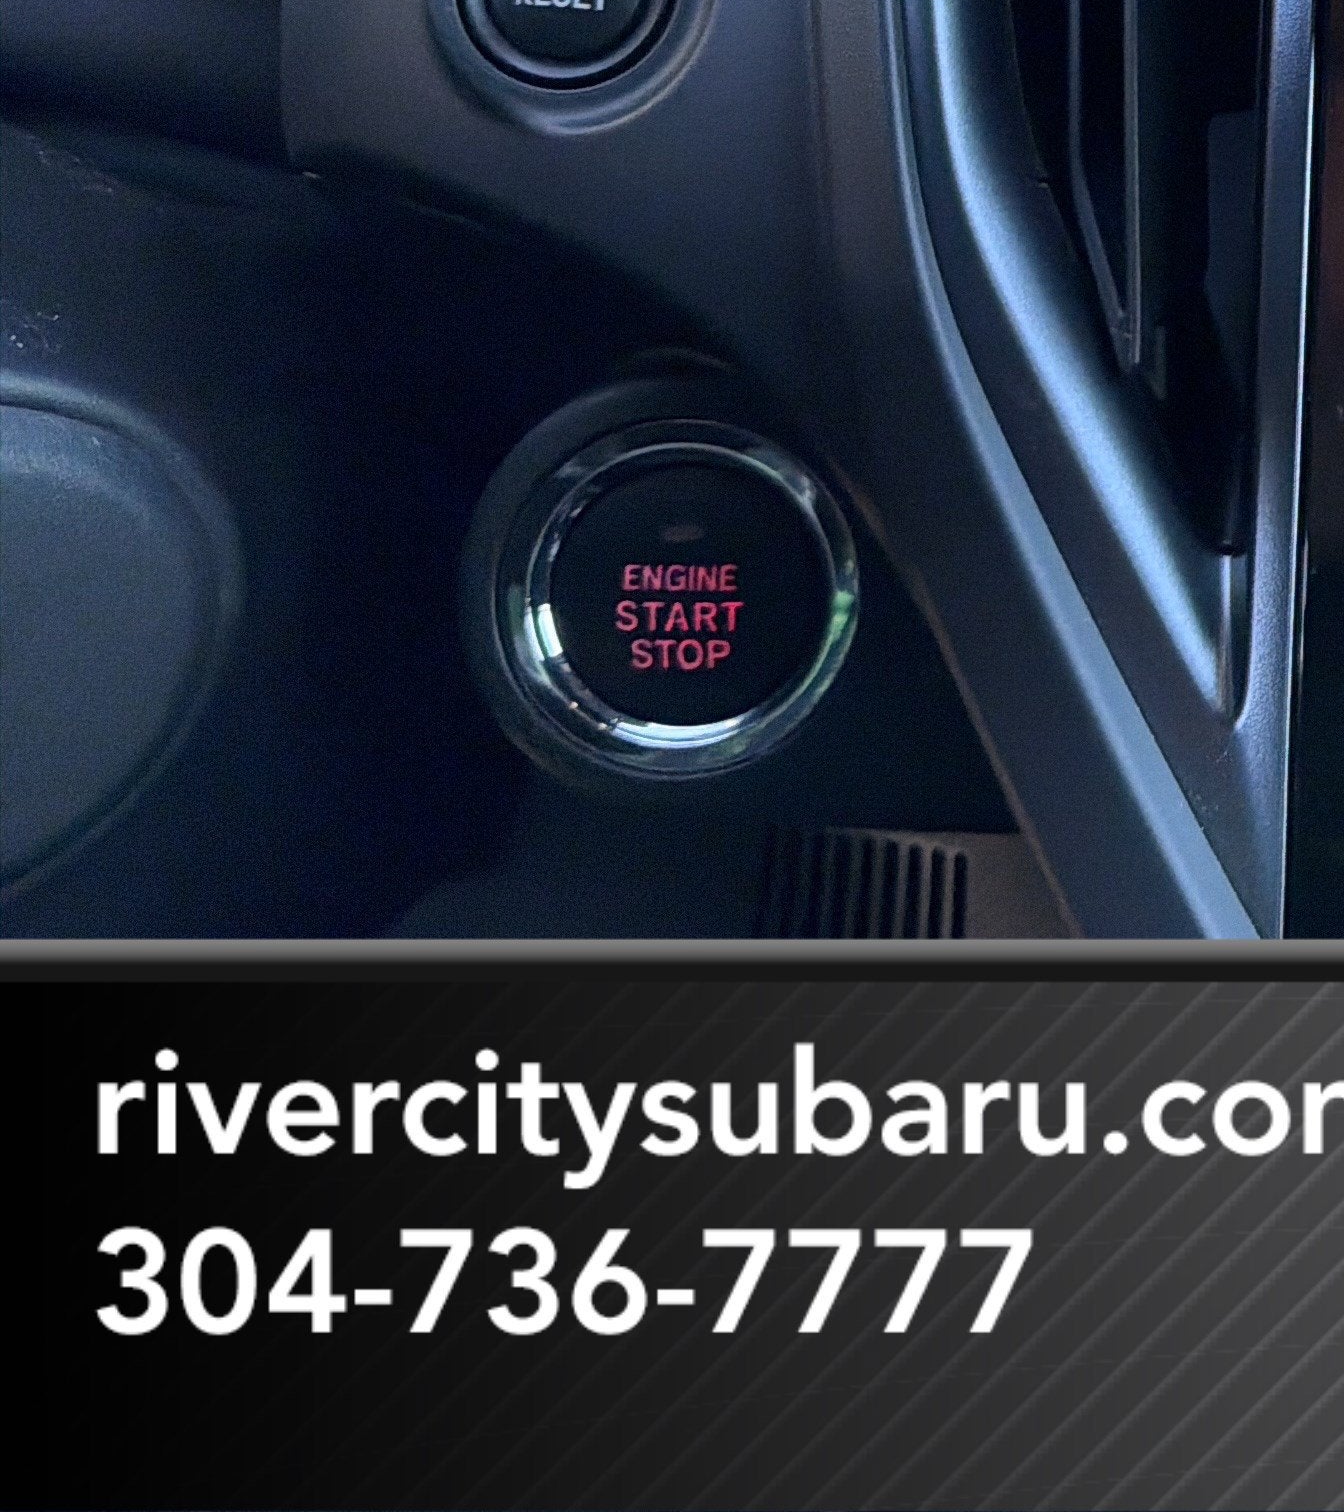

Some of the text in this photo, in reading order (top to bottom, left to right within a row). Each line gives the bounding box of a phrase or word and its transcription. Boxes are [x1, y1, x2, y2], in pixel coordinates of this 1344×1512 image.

[621, 564, 738, 592] ENGINE
[615, 601, 744, 632] START
[630, 638, 732, 670] STOP
